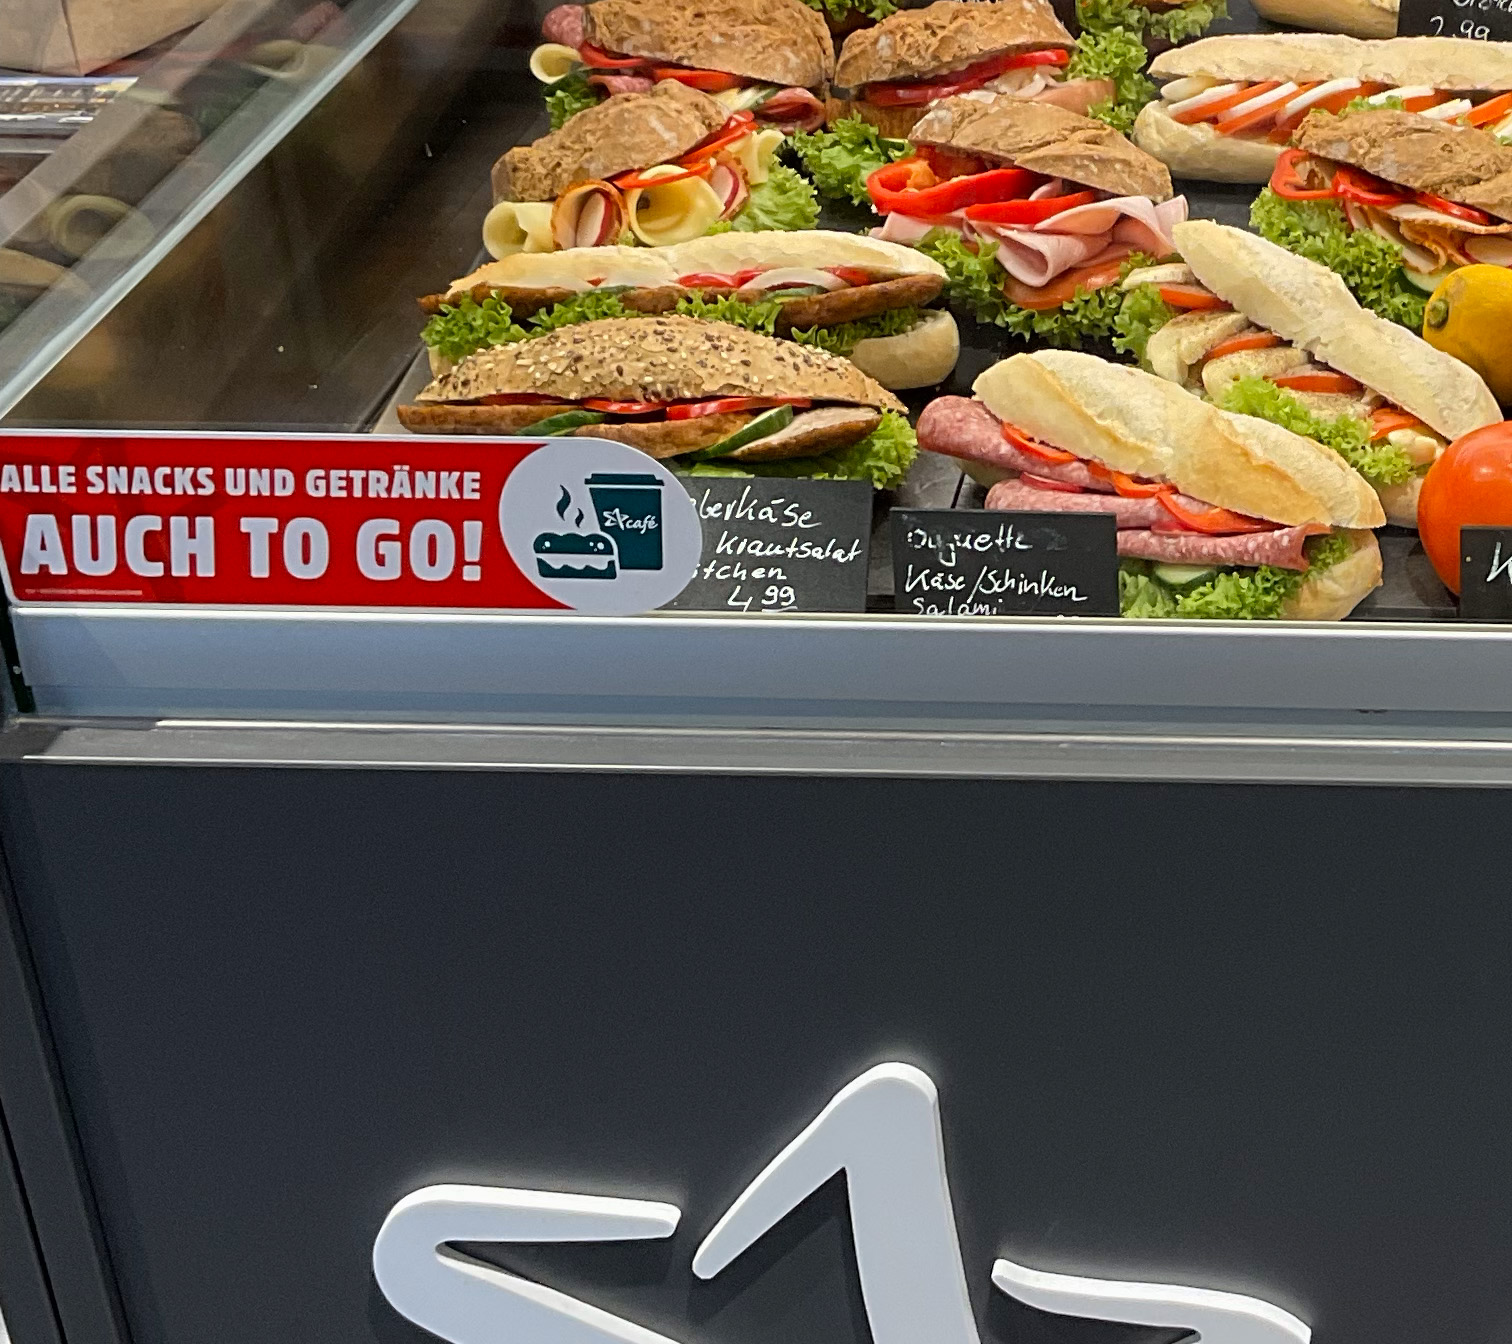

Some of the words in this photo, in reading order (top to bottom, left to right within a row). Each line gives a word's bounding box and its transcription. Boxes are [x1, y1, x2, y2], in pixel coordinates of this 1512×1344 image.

[0, 464, 77, 495] ALLE
[86, 465, 216, 498] SNACKS
[224, 467, 296, 498] UND
[304, 464, 482, 501] GETRÄNKE
[625, 514, 659, 535] café
[20, 513, 217, 579] AUCH
[239, 517, 331, 580] TO
[354, 519, 485, 582] GO!
